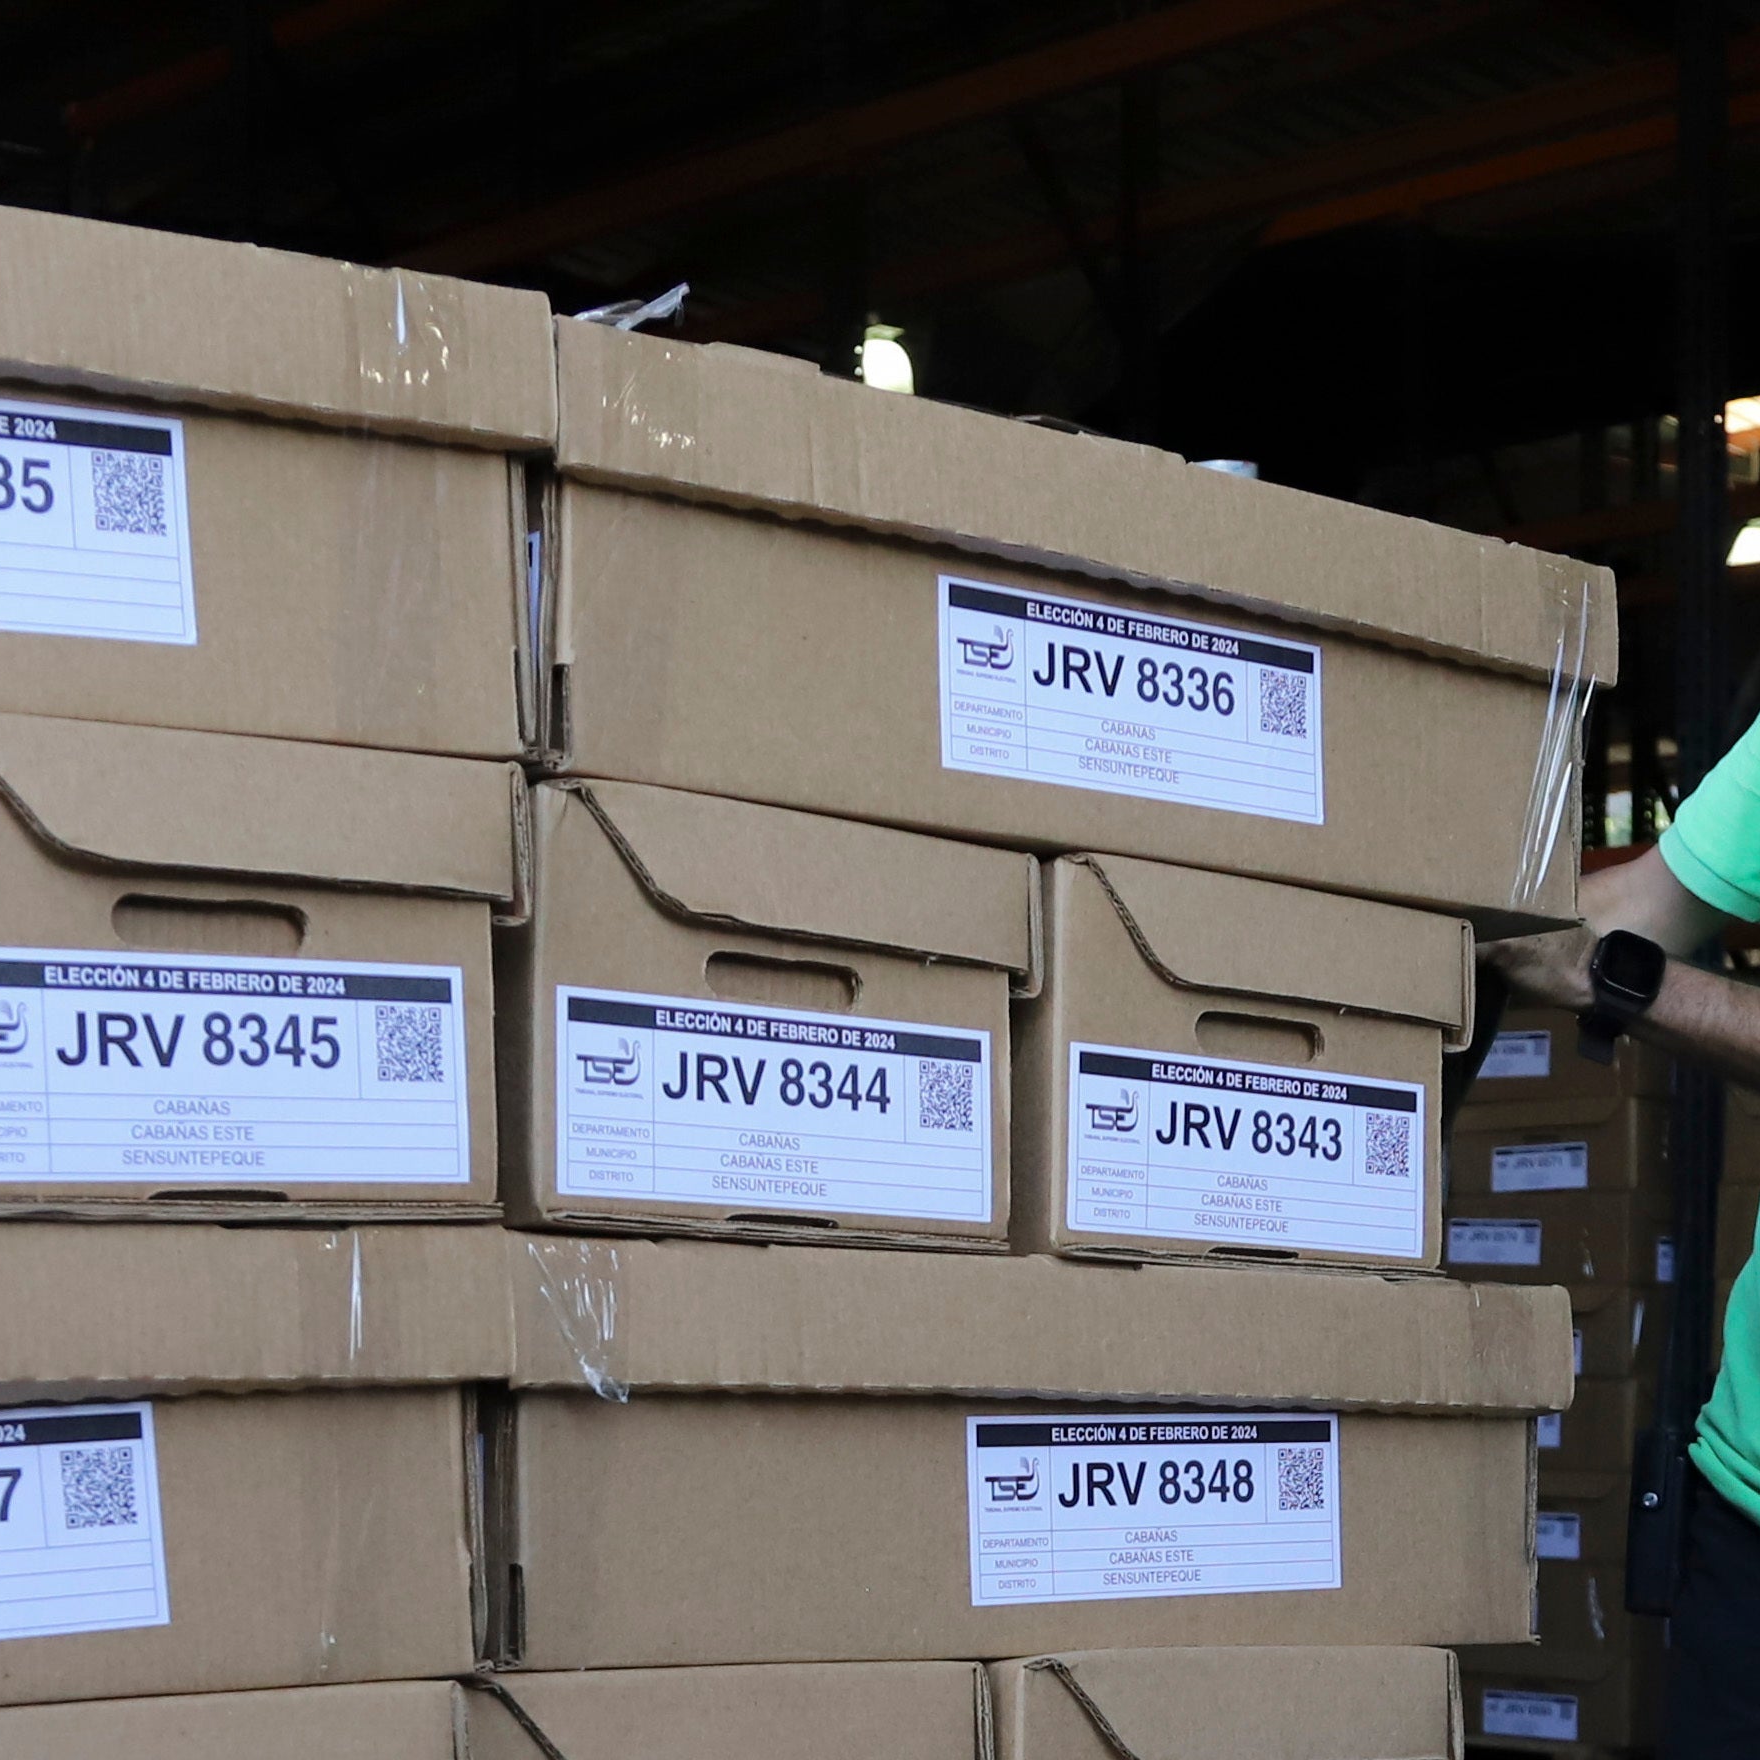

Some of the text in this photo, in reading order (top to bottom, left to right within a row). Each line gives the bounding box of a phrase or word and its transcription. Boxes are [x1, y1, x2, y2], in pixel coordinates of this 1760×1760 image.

[12, 415, 56, 441] 2024
[1032, 641, 1235, 716] JRV 8336
[56, 1011, 340, 1069] JRV 8345
[661, 1051, 891, 1113] JRV 8344
[1151, 1060, 1347, 1100] ELECCIÓN 4 DE FEBRERO DE 2024
[212, 1125, 254, 1140] ESTE
[1155, 1100, 1342, 1161] JRV 8343
[122, 1150, 265, 1165] SENSUNTEPEQUE
[785, 1159, 818, 1174] ESTE
[1081, 1164, 1144, 1181] DEPARTAMENTO
[712, 1175, 826, 1197] SENSUNTEPEQUE
[1092, 1186, 1133, 1200] MUNICIPIO
[1093, 1206, 1130, 1220] DISTRITO
[1057, 1458, 1254, 1508] JRV 8348
[983, 1536, 1049, 1550] DEPARTAMENTO
[995, 1558, 1038, 1569] MUNICIPIO
[1165, 1549, 1194, 1562] ESTE
[997, 1578, 1036, 1590] DISTRITO
[1103, 1568, 1201, 1585] SENSUNTEPEQUE
